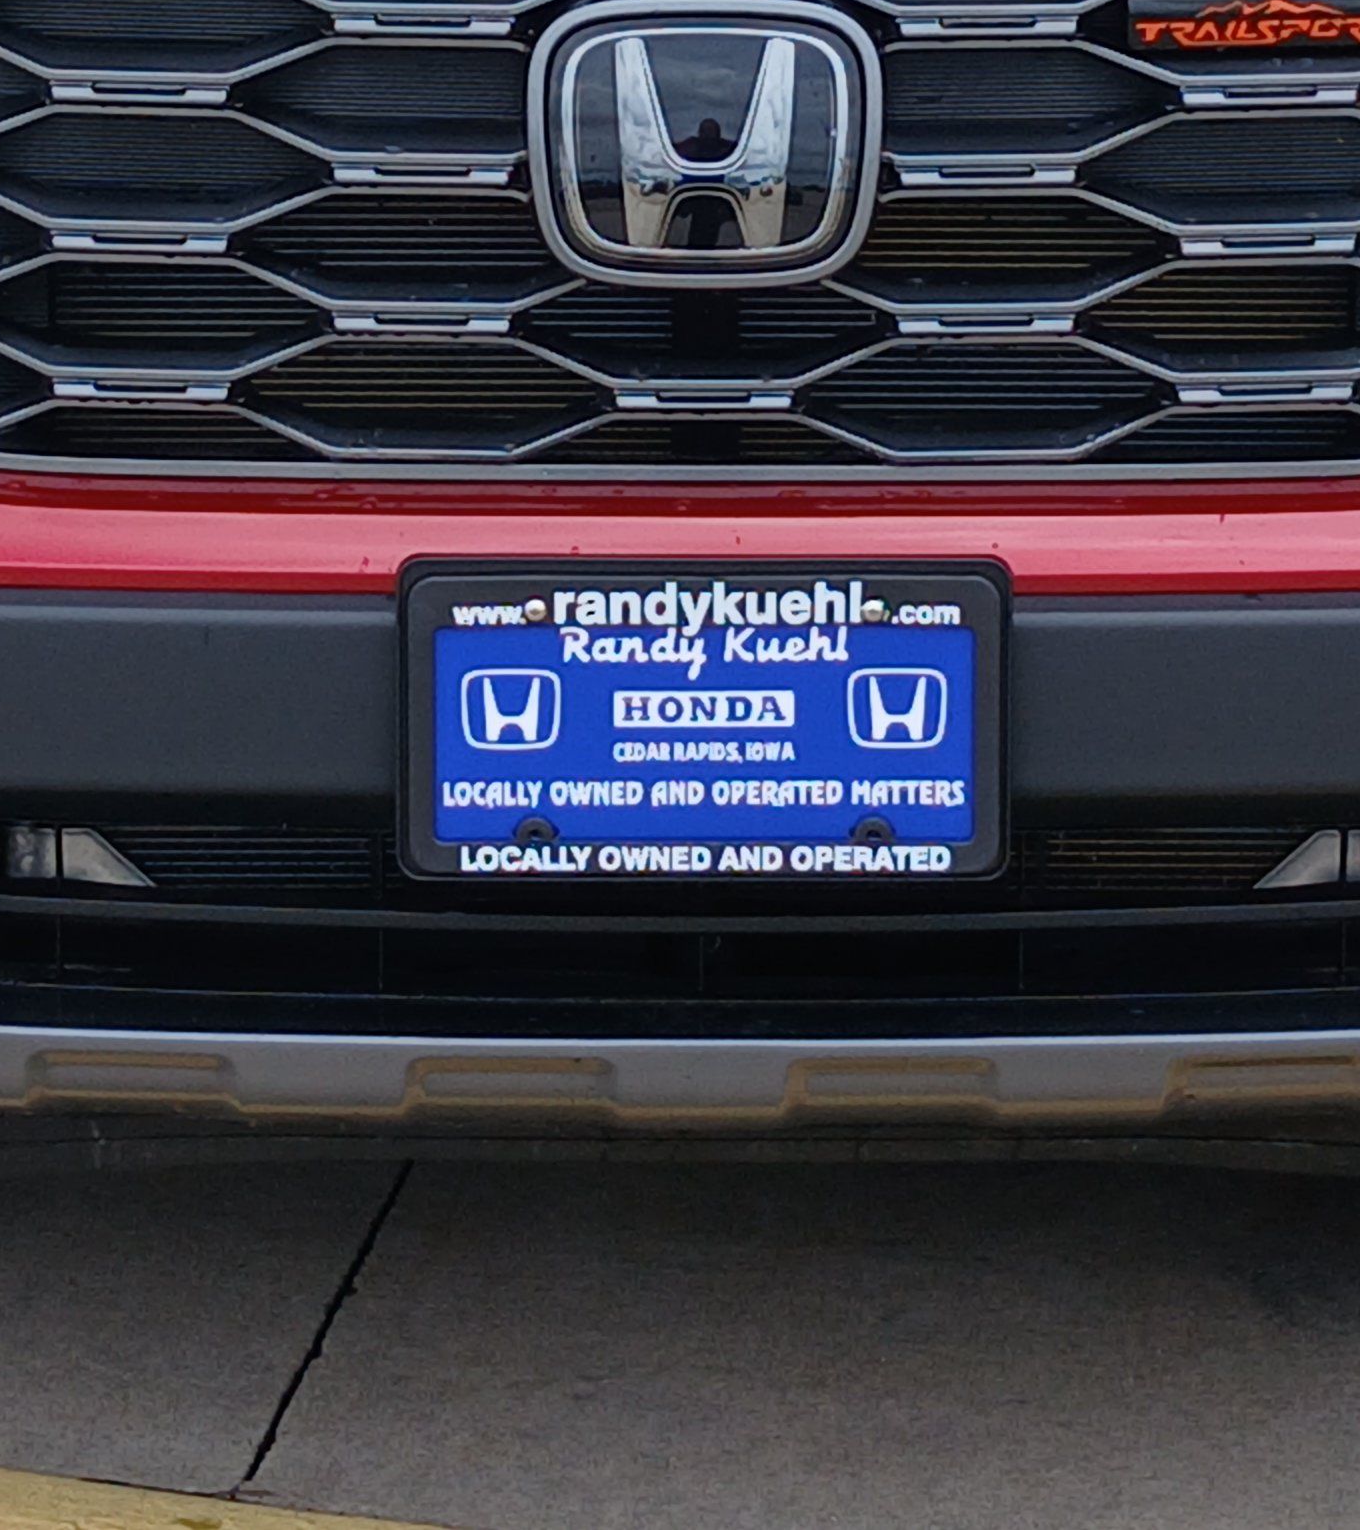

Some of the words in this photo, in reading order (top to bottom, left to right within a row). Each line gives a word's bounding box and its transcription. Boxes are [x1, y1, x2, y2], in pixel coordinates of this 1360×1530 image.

[552, 581, 863, 636] randykuehl
[559, 625, 708, 681] Randy
[723, 626, 849, 663] Kuehl
[621, 695, 787, 722] HONDA
[612, 741, 671, 763] CEDAR
[745, 741, 797, 762] IOWA
[442, 780, 543, 809] LOCALLY
[549, 780, 644, 807] OWNED
[651, 780, 705, 807] AND
[711, 779, 844, 807] OPERATED
[850, 779, 966, 807] MATTERS
[460, 845, 592, 872] LOCALLY
[597, 845, 712, 872] OWNED
[717, 845, 784, 872] AND
[789, 845, 952, 872] OPERATED
